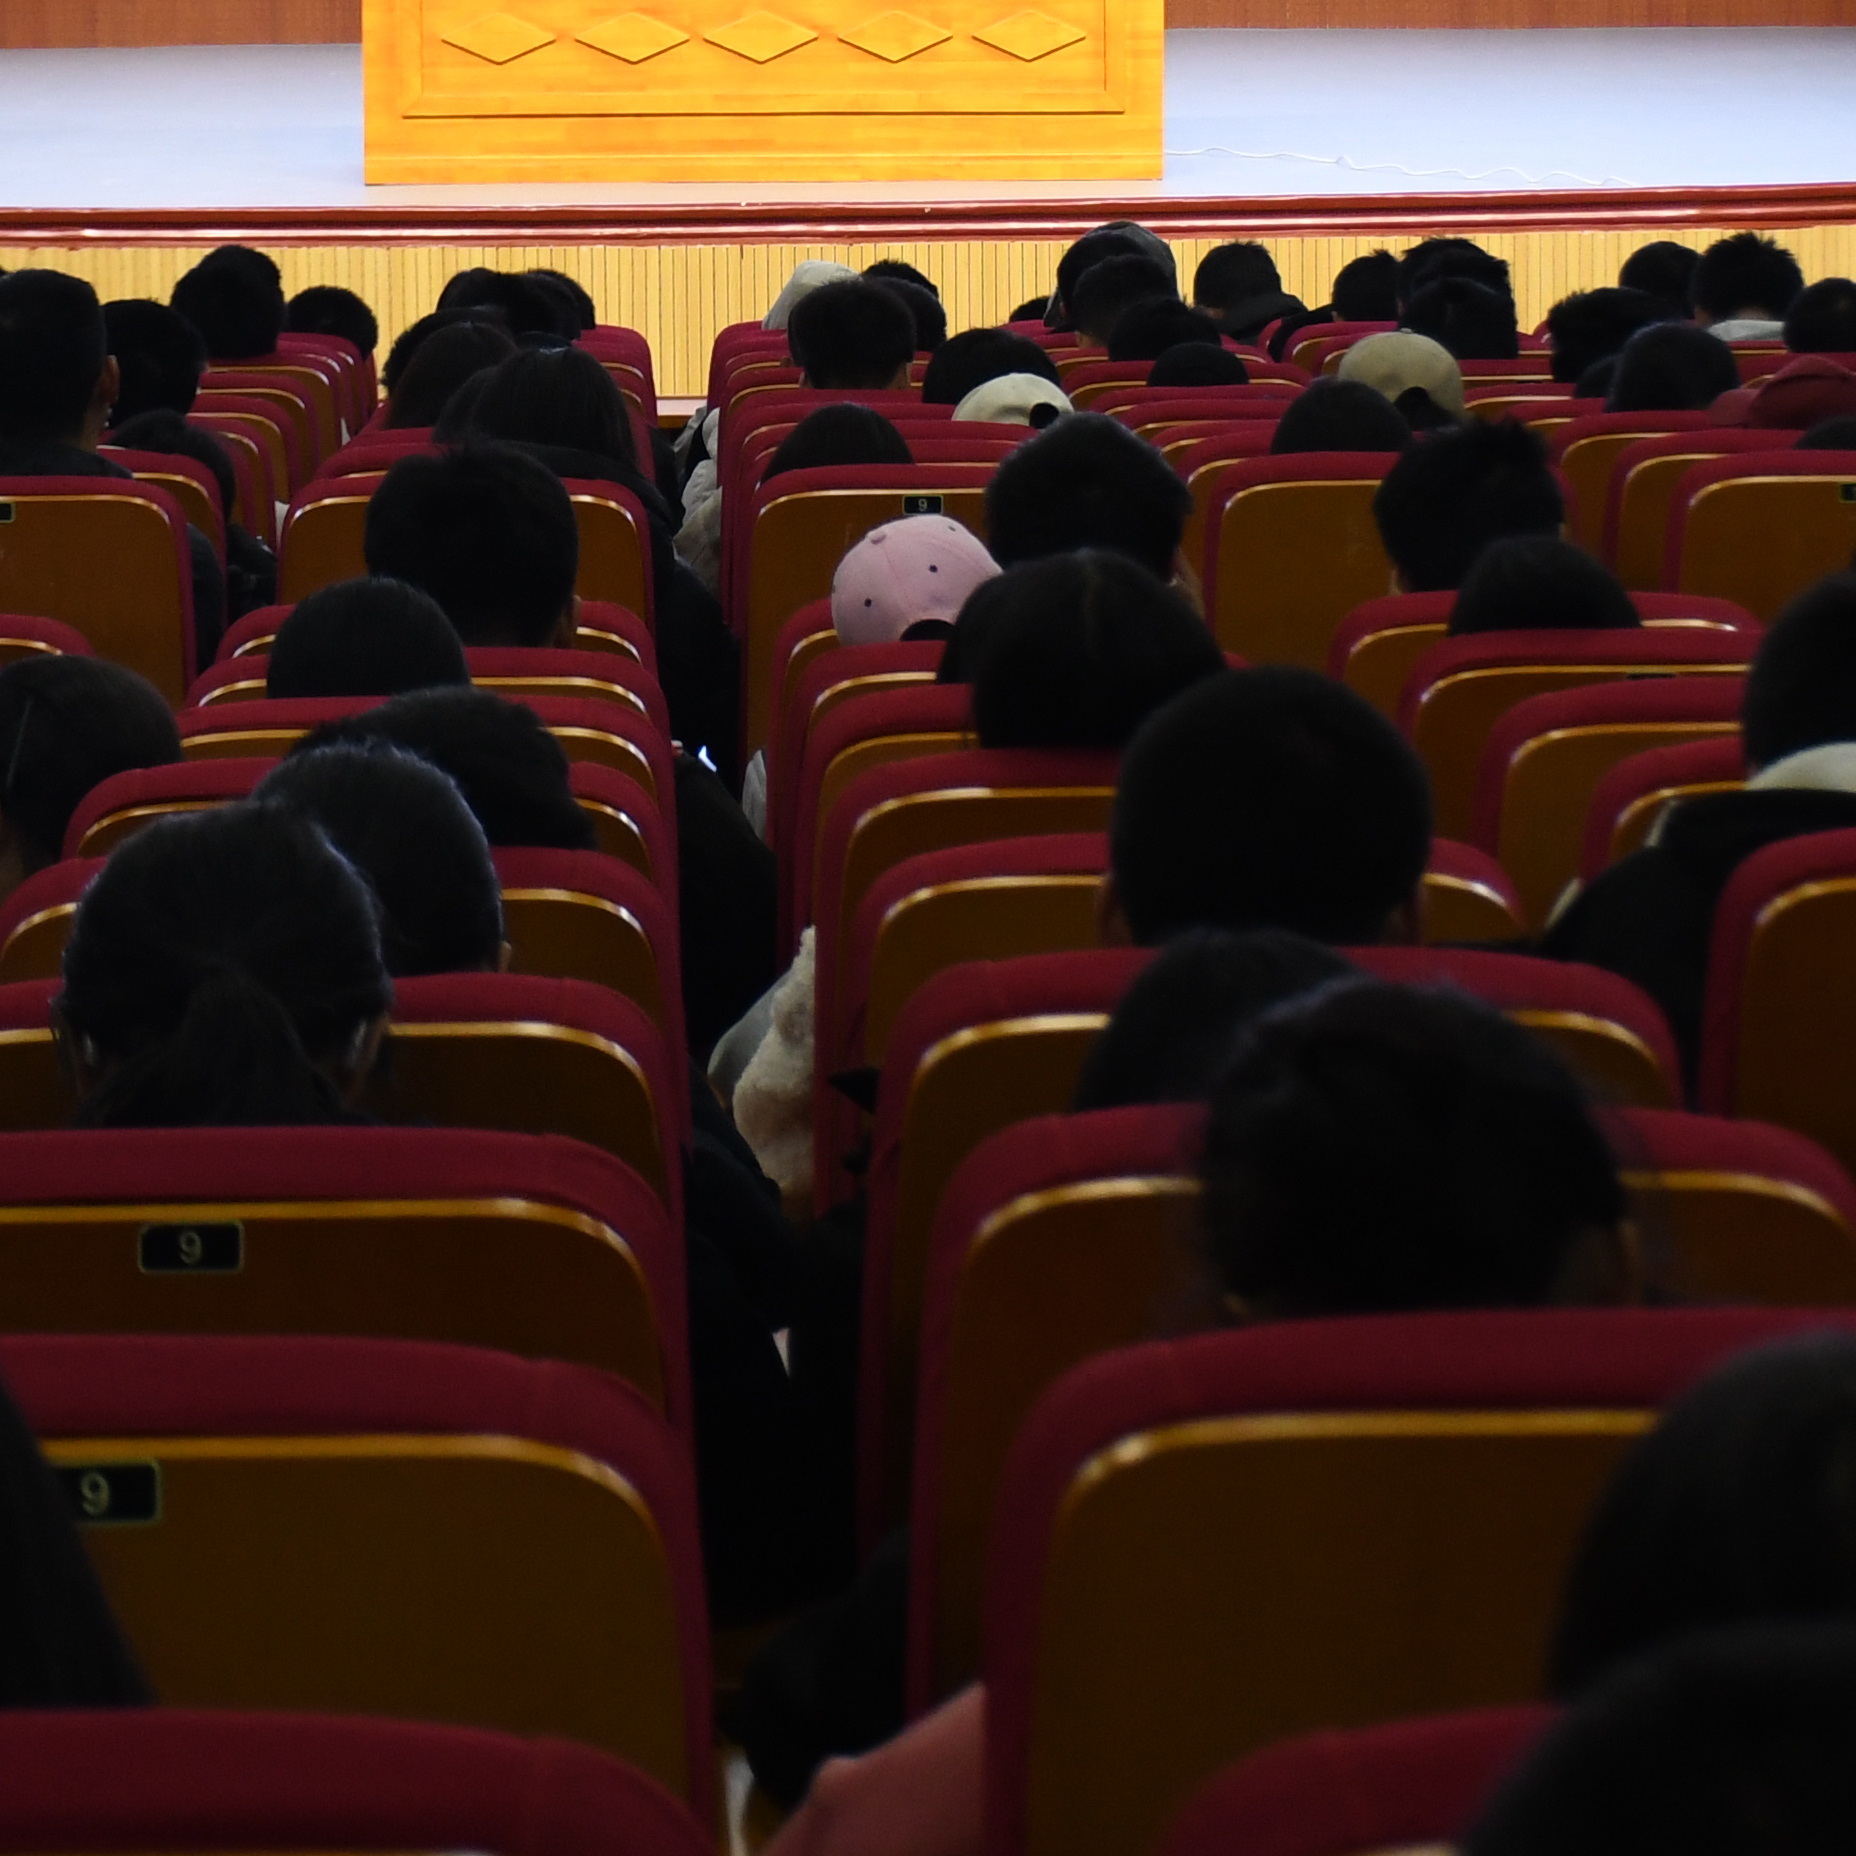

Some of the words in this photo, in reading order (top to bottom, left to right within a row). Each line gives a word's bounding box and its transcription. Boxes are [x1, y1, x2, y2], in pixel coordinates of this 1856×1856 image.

[917, 498, 928, 511] 9
[179, 1229, 204, 1265] 9
[80, 1471, 111, 1515] 9
